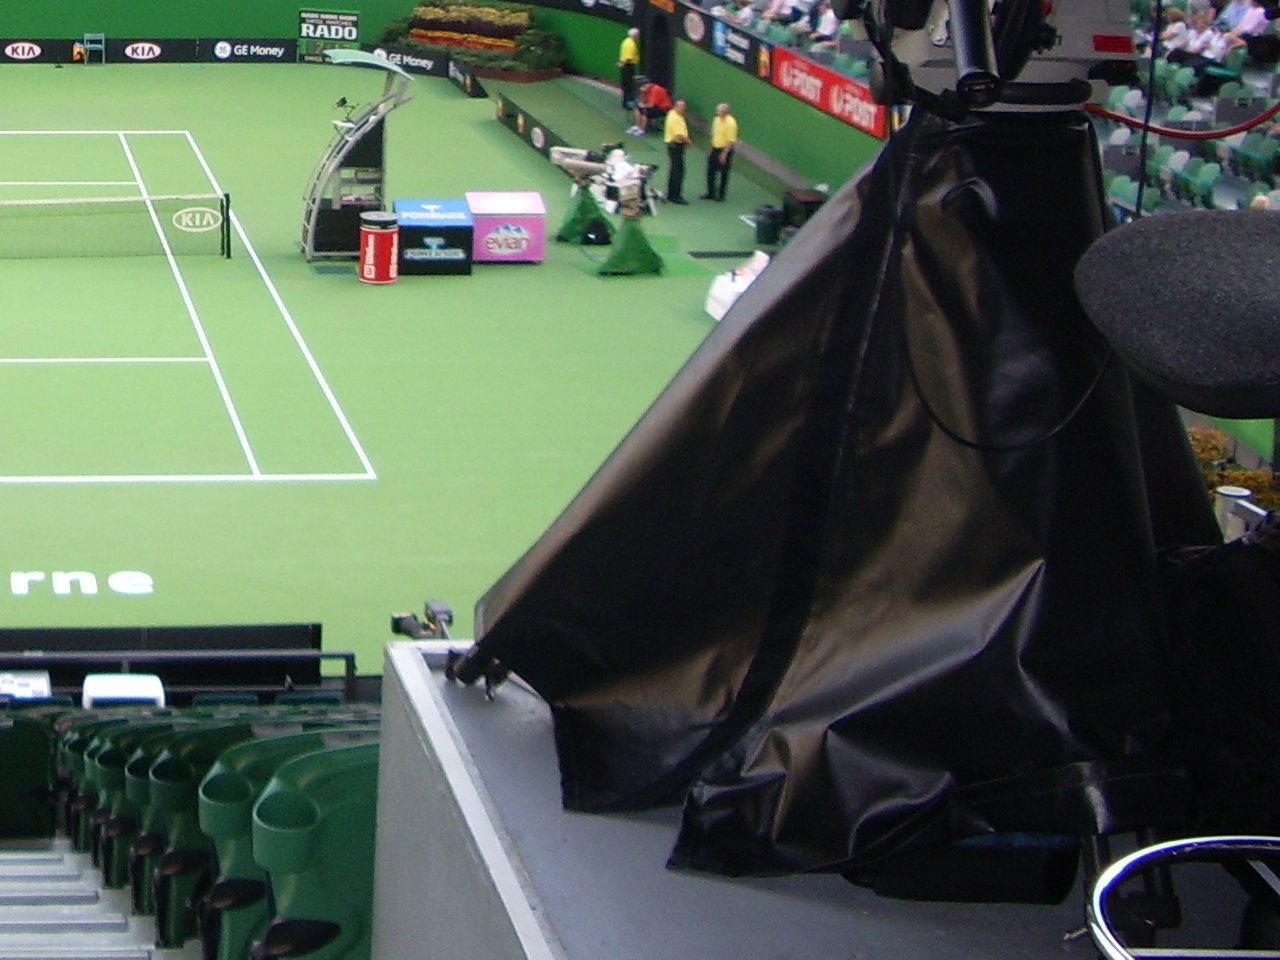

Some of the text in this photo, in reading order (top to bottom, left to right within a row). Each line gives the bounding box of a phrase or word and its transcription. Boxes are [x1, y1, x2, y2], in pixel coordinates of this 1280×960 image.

[300, 23, 357, 41] RADO
[11, 46, 34, 56] KIA
[131, 46, 154, 56] KIA
[234, 45, 285, 59] GE Money
[181, 213, 214, 226] KIA
[486, 235, 528, 250] evian
